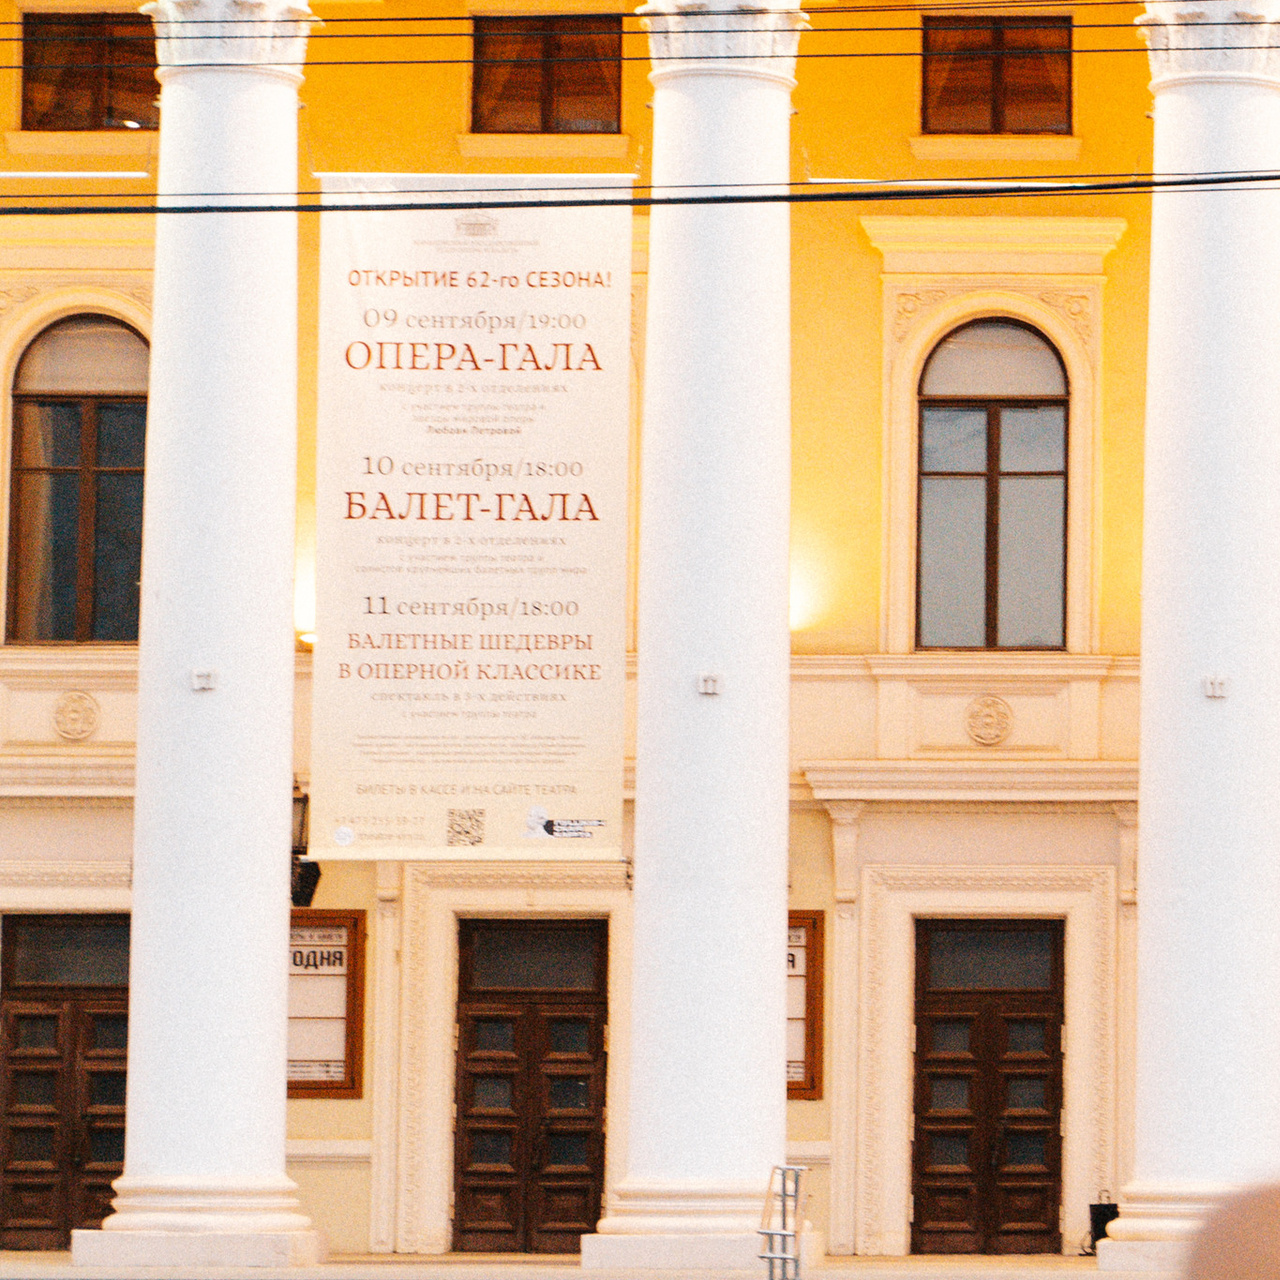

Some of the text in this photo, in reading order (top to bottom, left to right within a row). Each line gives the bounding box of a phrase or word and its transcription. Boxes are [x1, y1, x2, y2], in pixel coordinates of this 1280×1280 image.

[348, 269, 612, 288] ОТКРЫТИЕ 62-го СЕЗОНА!
[364, 308, 399, 330] 09
[345, 341, 603, 371] ОПЕРА-ГАЛА
[363, 456, 393, 475] 10
[344, 490, 600, 522] БАЛЕТ-ГАЛА
[362, 596, 389, 615] 11
[347, 632, 594, 654] БАЛЕТНЫЕ ШЕДЕВРЫ
[338, 659, 602, 681] В ОПЕРНОЙ КЛАССИКЕ
[290, 950, 344, 970] ОДНЯ
